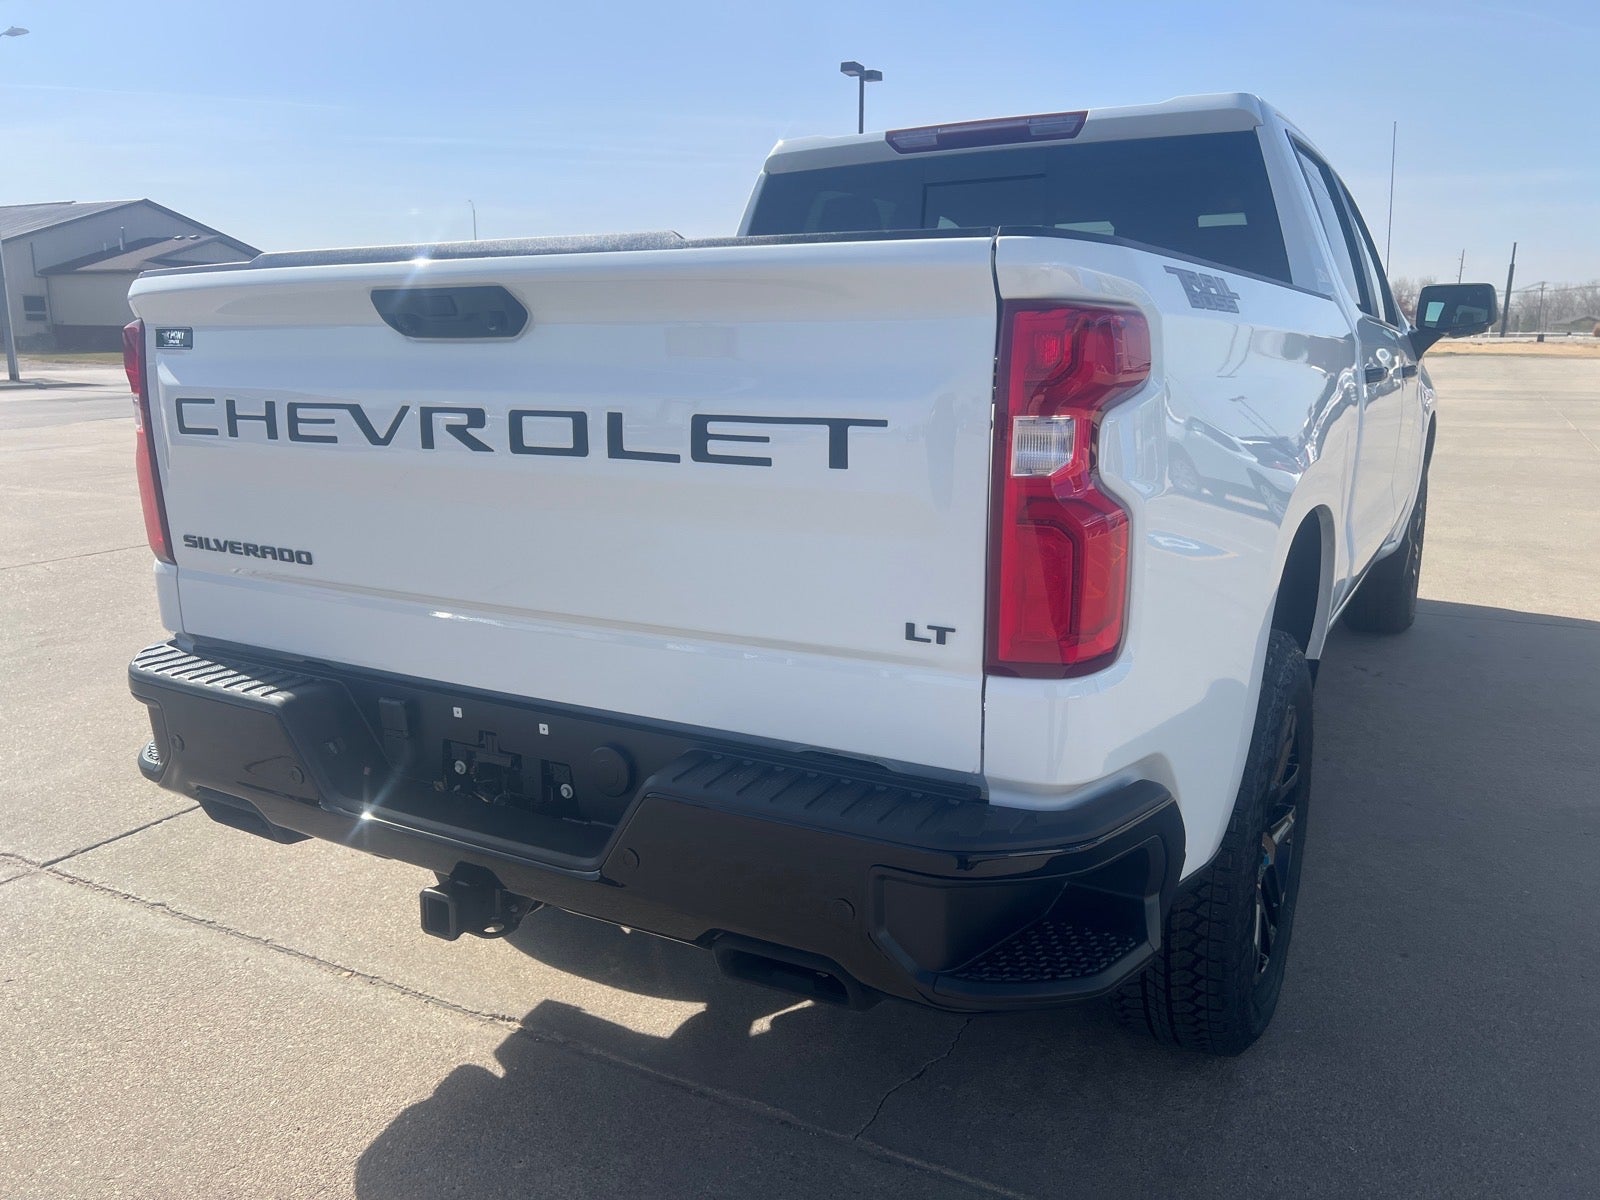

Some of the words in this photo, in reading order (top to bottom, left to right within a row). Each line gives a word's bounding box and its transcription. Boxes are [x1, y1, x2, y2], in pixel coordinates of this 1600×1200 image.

[175, 397, 889, 469] CHEVROLET
[182, 534, 313, 566] SILVERADO
[905, 622, 956, 645] LT
